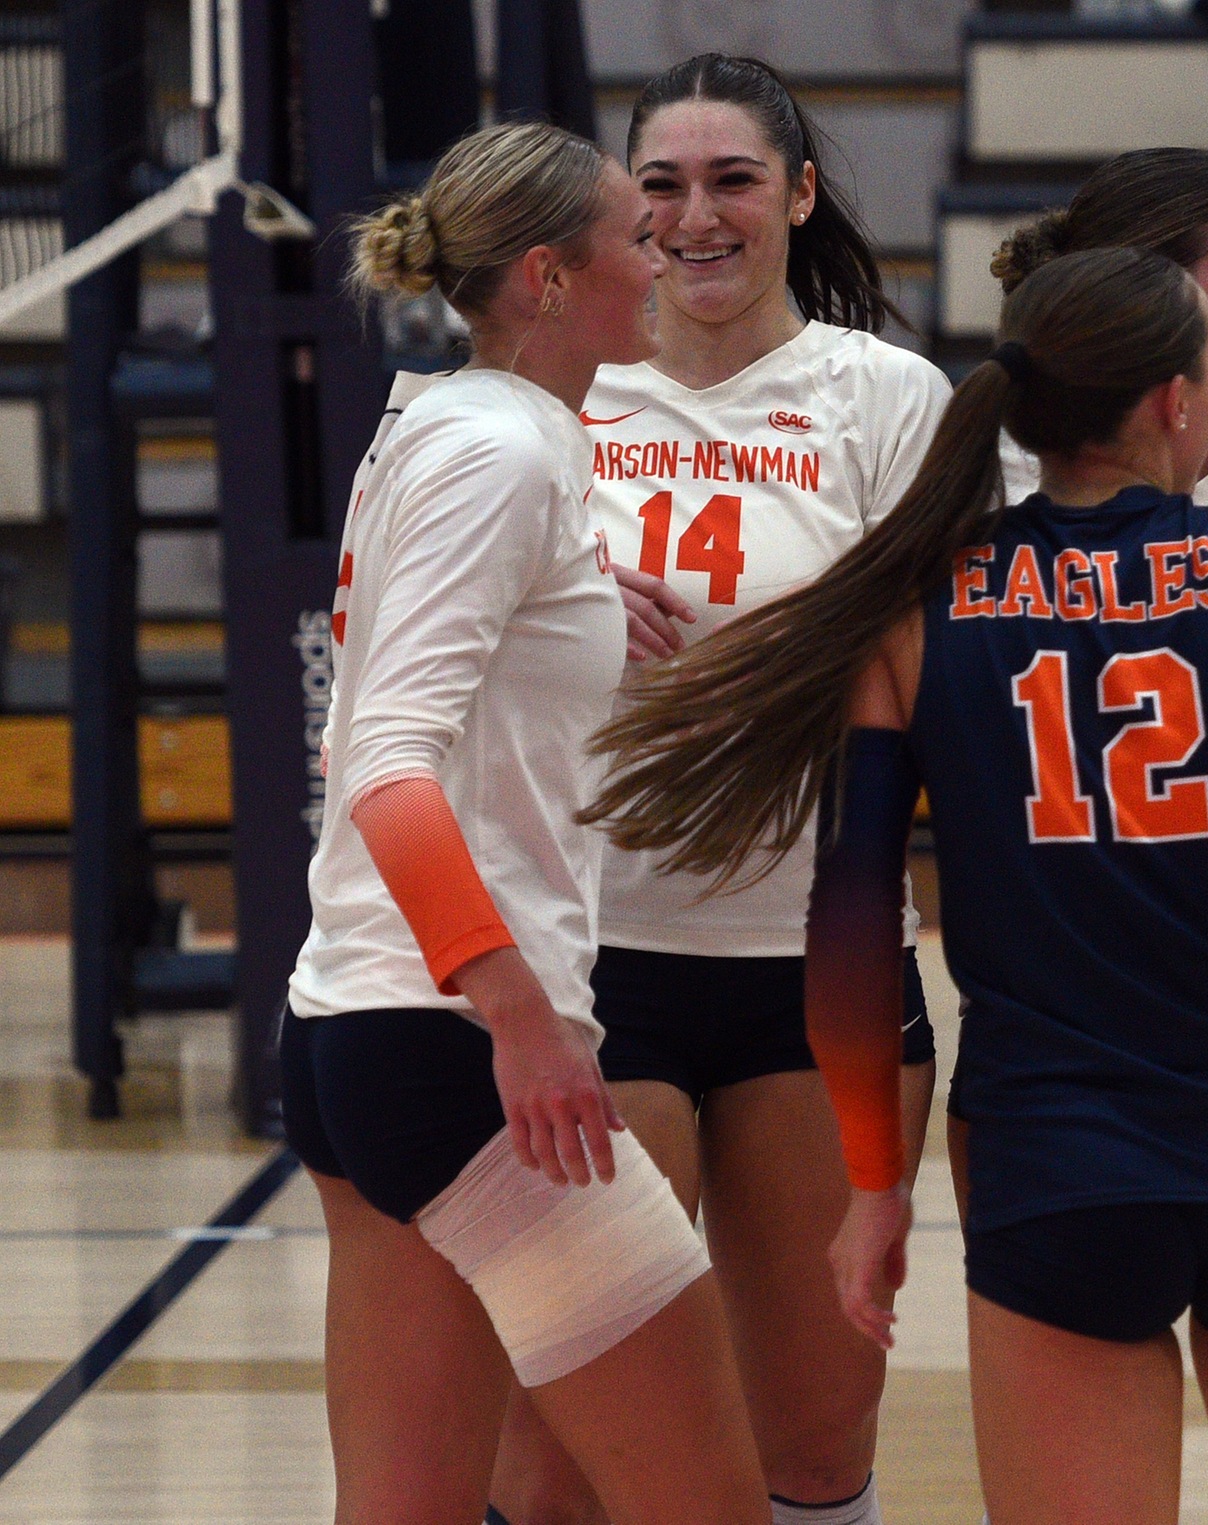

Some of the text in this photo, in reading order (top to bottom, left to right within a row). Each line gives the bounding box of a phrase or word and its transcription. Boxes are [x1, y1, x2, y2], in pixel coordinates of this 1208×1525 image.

[773, 411, 812, 430] SAC
[592, 440, 820, 493] ARSON-NEWMAN
[638, 490, 745, 606] 14
